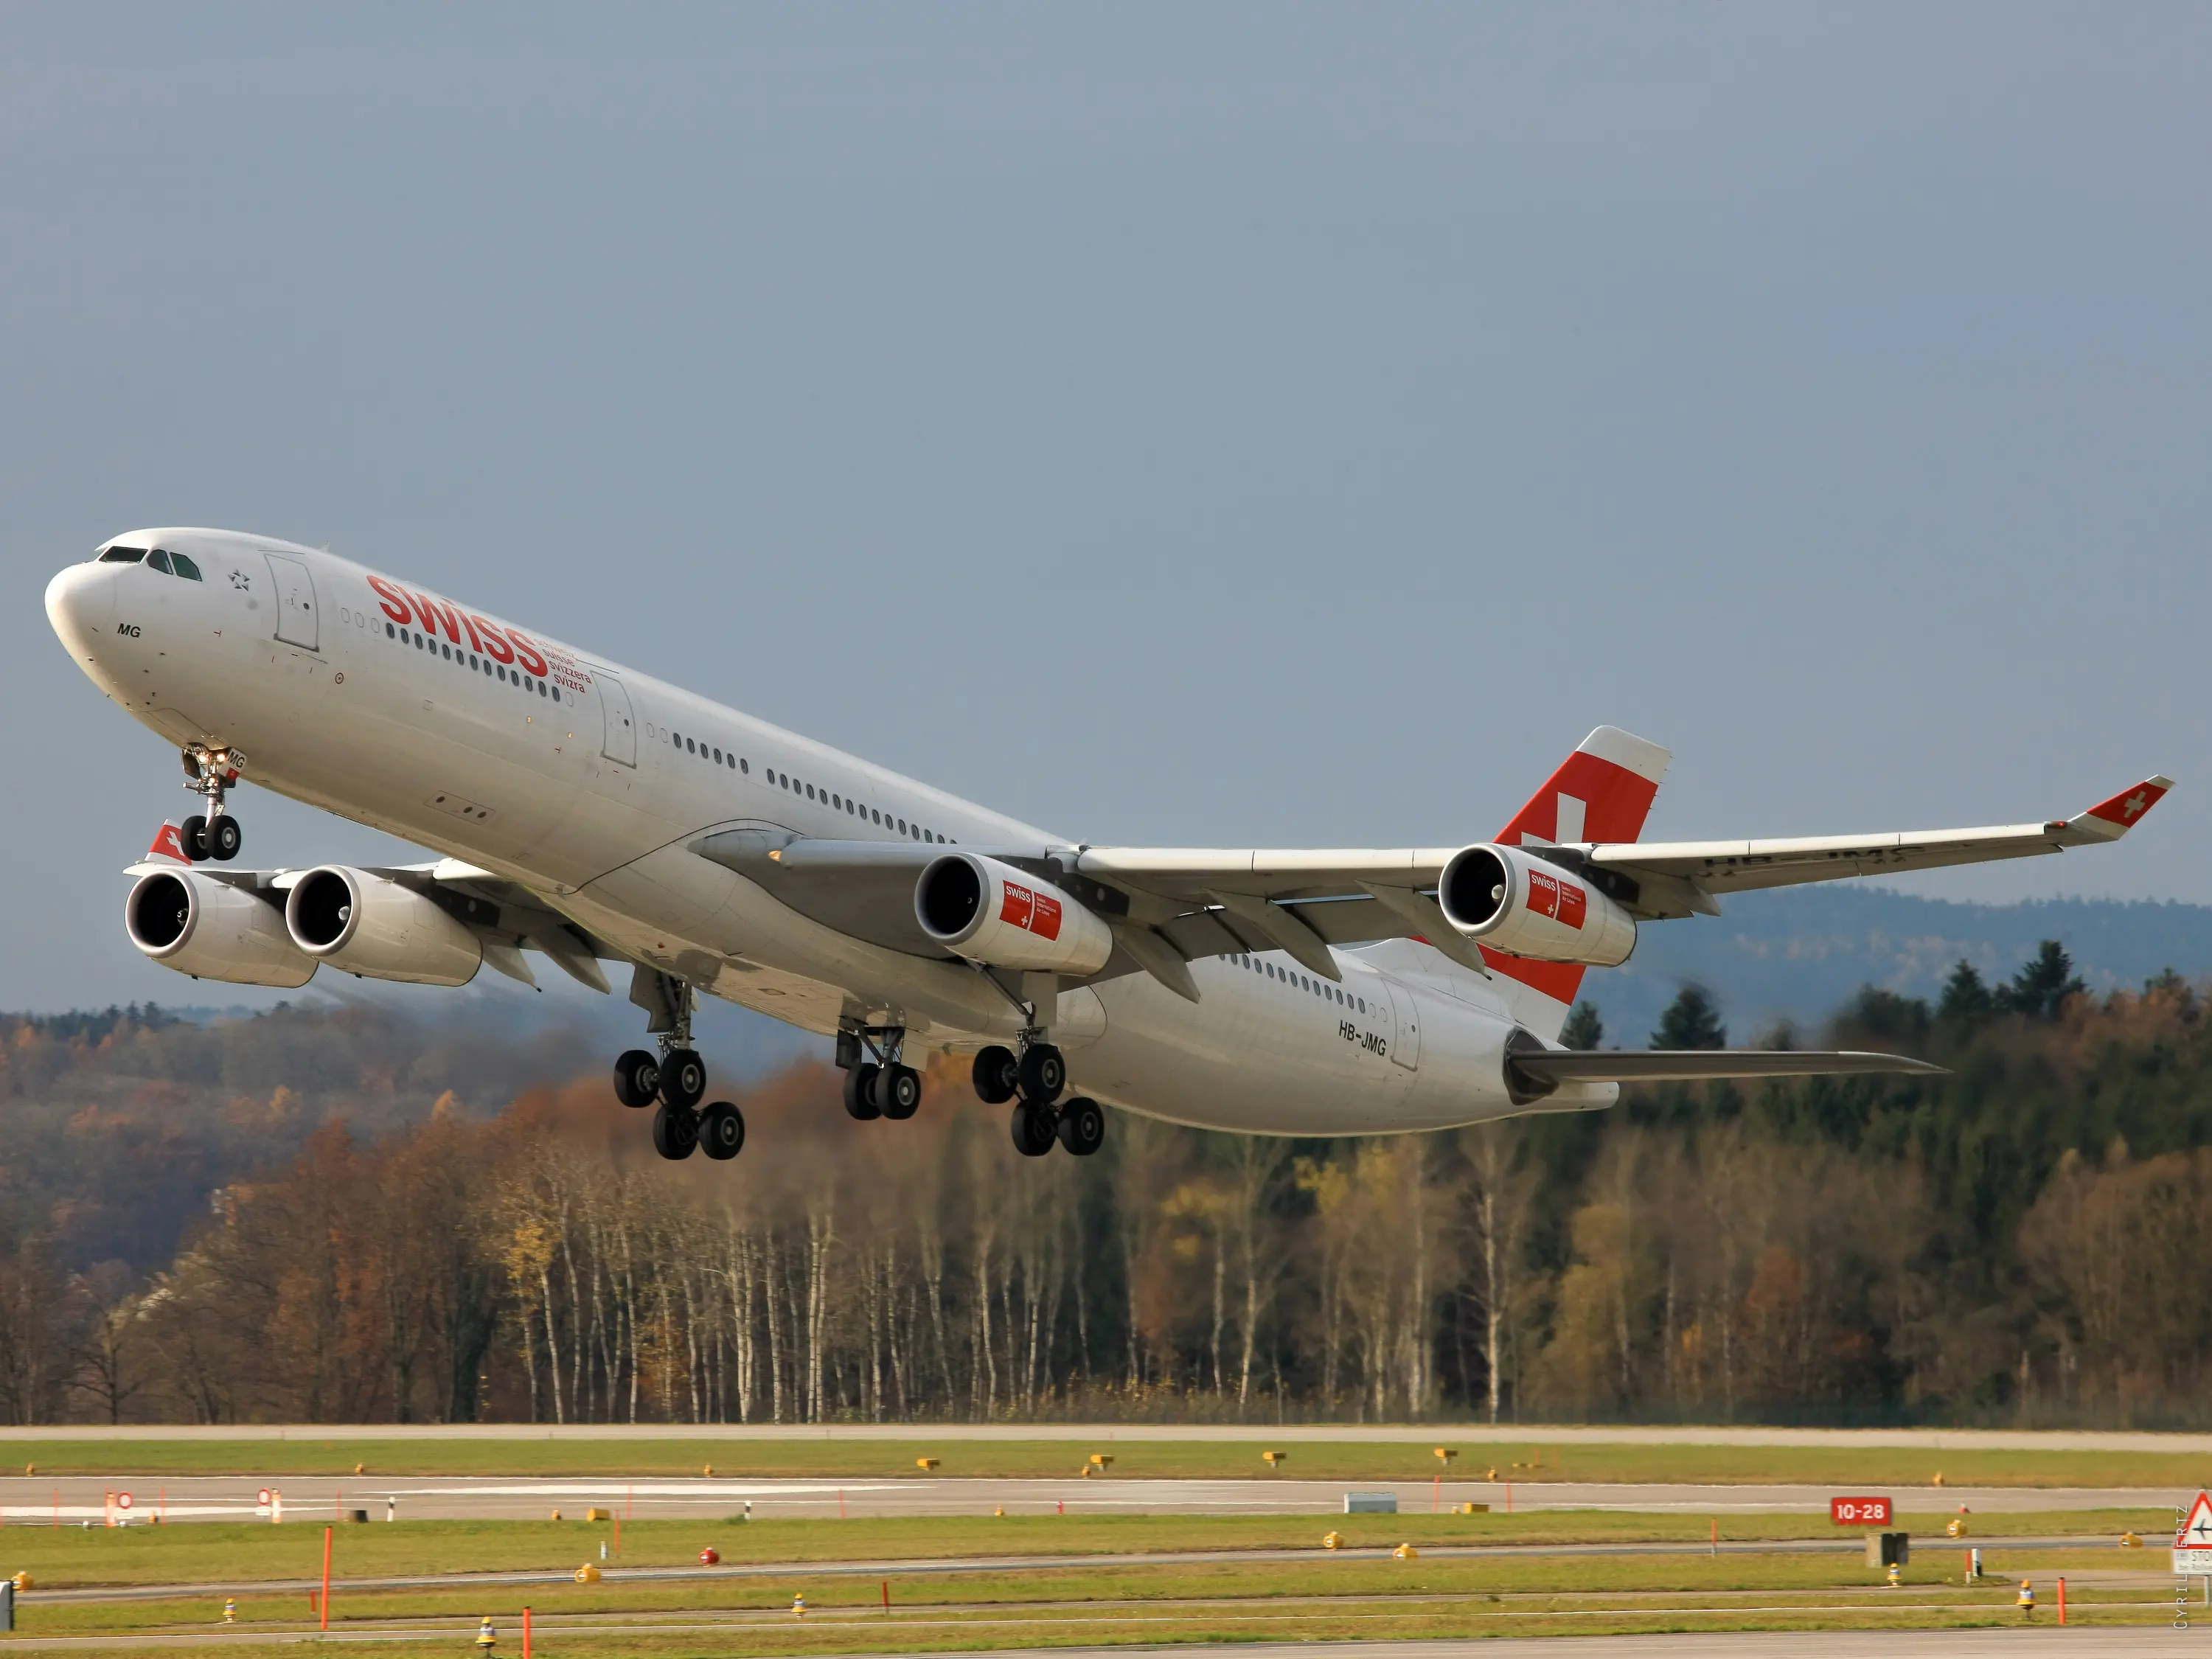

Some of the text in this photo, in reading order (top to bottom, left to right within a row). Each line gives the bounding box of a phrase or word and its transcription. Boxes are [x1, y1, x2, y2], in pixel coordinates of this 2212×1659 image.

[117, 623, 141, 638] MG
[542, 649, 574, 667] suisse
[549, 661, 592, 684] svizzera
[554, 674, 585, 693] svizra
[227, 751, 245, 768] MG
[1339, 1020, 1386, 1057] HB-JMG
[1837, 1504, 1885, 1519] 10-28
